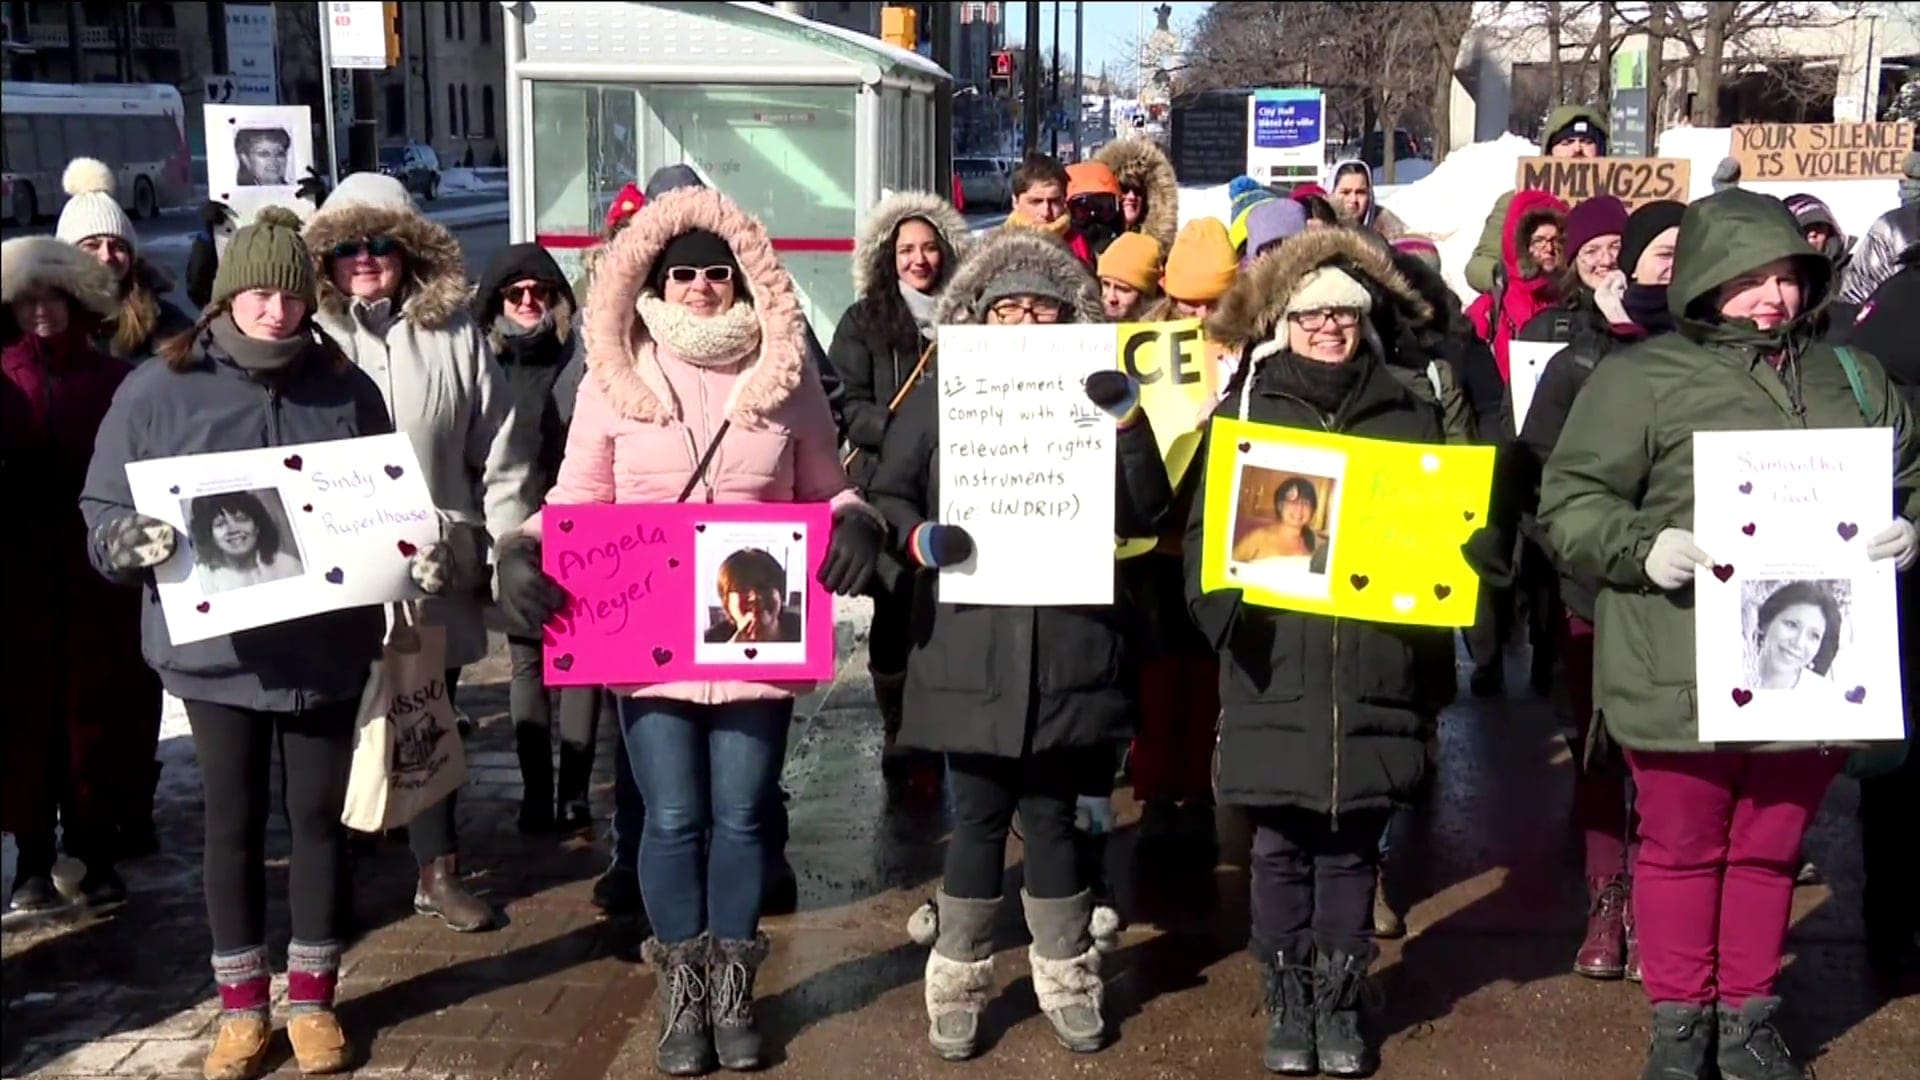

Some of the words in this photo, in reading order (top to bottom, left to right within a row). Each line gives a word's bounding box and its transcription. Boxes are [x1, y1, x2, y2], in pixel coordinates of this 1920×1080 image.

[1259, 107, 1275, 117] City
[1278, 106, 1295, 116] Hall
[1296, 118, 1314, 126] ville
[1736, 125, 1796, 150] YOUR
[1810, 123, 1907, 150] SILENCE
[1757, 152, 1783, 176] IS
[1796, 150, 1904, 177] VIOLENCE
[1524, 161, 1676, 199] MMIWG2S
[975, 375, 1064, 400] Implement
[1019, 403, 1055, 421] with
[1069, 403, 1103, 421] ALL
[949, 439, 1029, 458] relevant
[1047, 432, 1102, 460] rights
[311, 468, 376, 498] Sindy
[954, 471, 1065, 489] instruments
[990, 493, 1080, 520] UNDRIP)
[558, 524, 667, 580] Angela
[566, 570, 654, 636] Meyer
